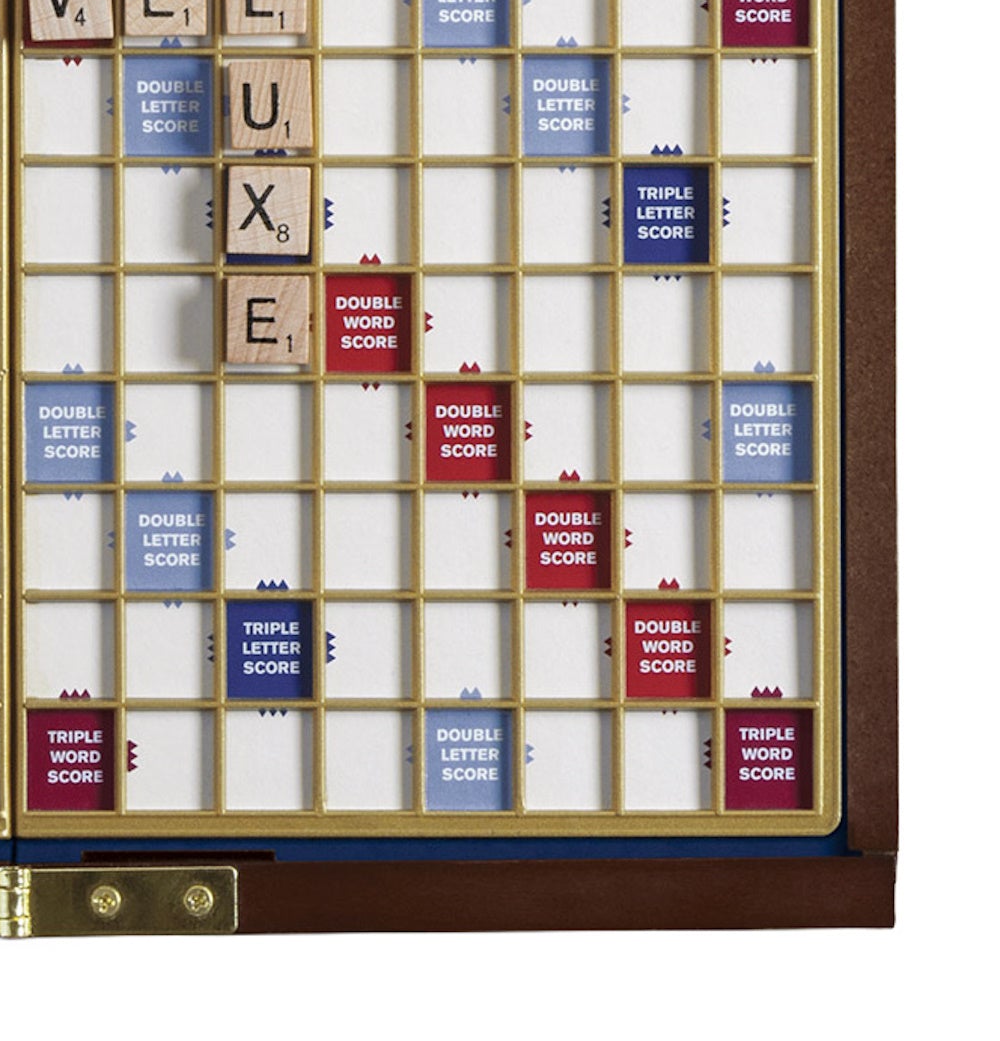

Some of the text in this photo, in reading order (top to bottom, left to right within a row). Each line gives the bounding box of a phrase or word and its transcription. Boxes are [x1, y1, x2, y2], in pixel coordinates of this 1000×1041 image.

[734, 8, 793, 24] SCORE
[334, 295, 403, 311] DOUBLE
[342, 314, 396, 331] WORD
[340, 334, 399, 350] SCORE
[38, 405, 106, 421] DOUBLE
[42, 424, 102, 440] LETTER
[43, 444, 101, 460] SCORE
[633, 619, 701, 635] DOUBLE
[641, 639, 695, 654] WORD
[638, 658, 697, 674] SCORE
[46, 729, 104, 745] TRIPLE
[738, 726, 796, 742] TRIPLE
[48, 749, 102, 765] WORD
[740, 746, 794, 762] WORD
[46, 768, 104, 785] SCORE
[738, 765, 796, 782] SCORE
